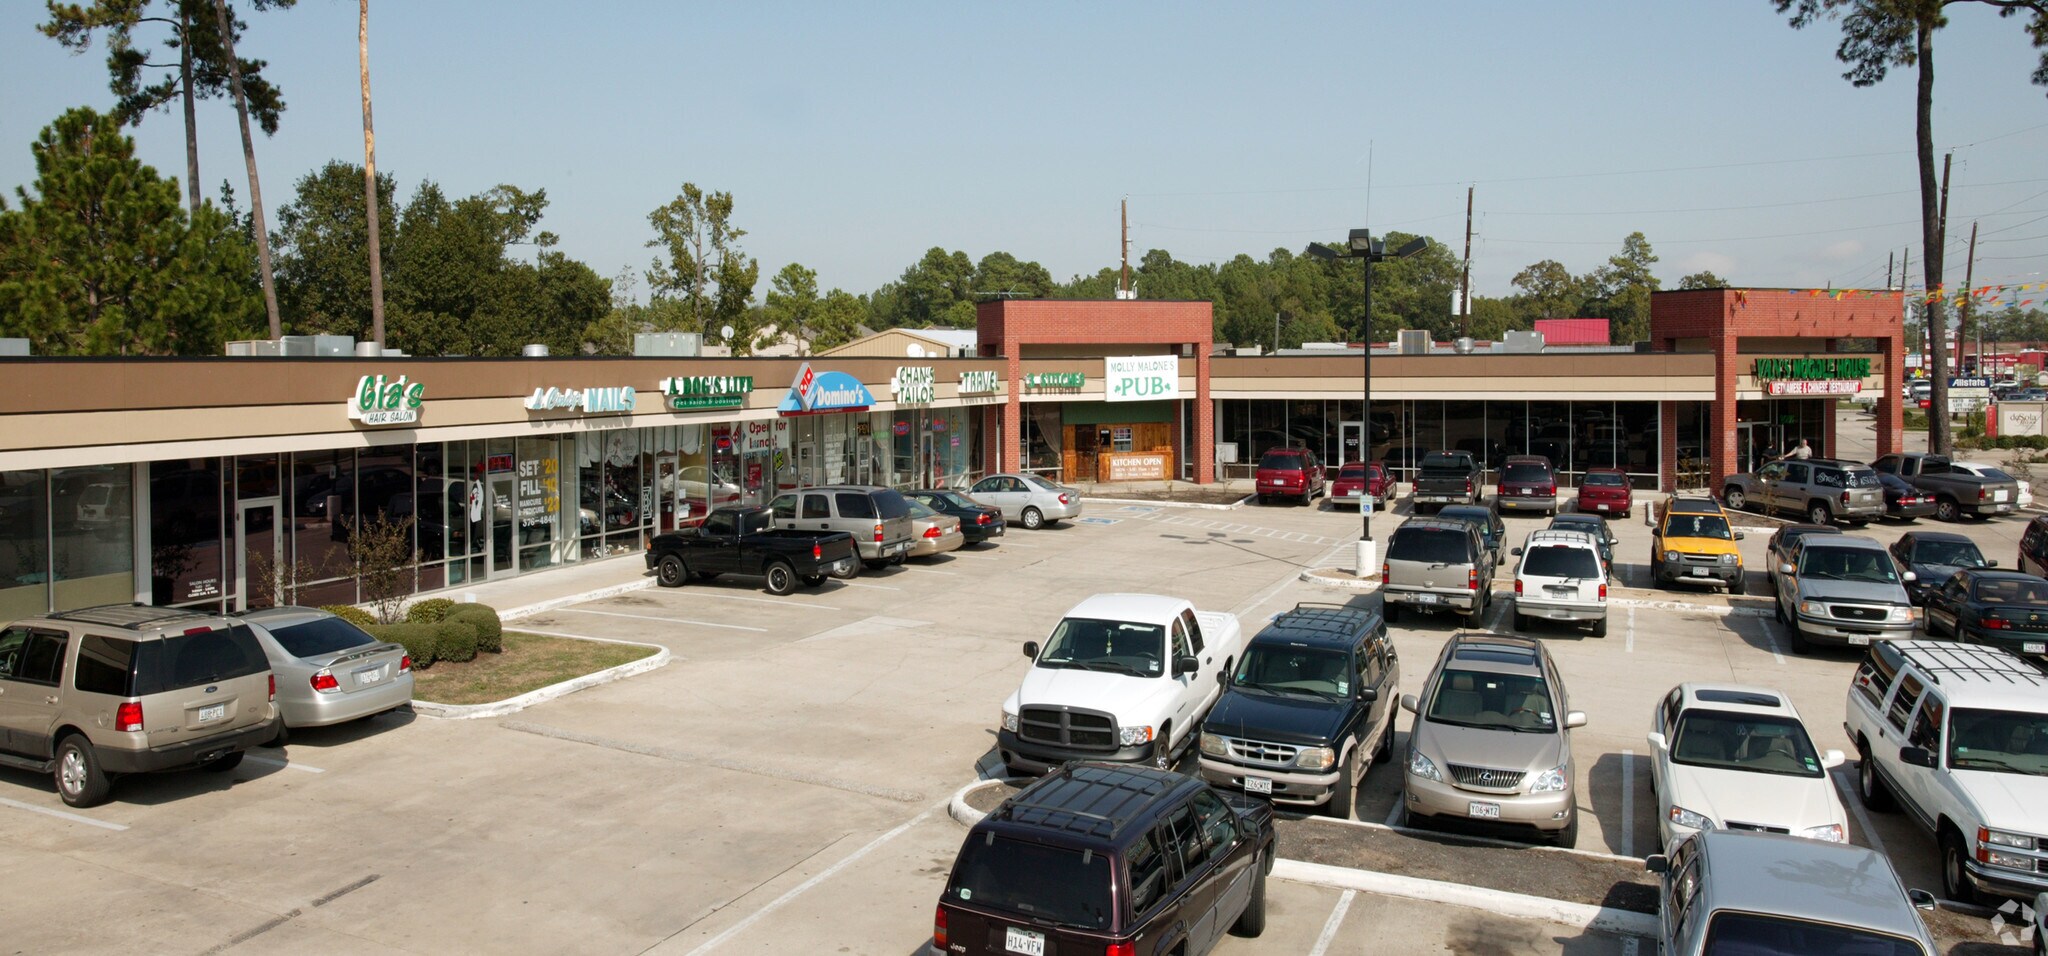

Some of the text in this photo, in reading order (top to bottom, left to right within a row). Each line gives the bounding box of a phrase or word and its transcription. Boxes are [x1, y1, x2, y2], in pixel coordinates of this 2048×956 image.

[1111, 361, 1175, 372] MOLLY MALONE'S
[1757, 358, 1871, 378] VAN'S NOODLE HOUSE
[899, 367, 934, 384] CHAN'S
[962, 371, 1000, 392] TRAVEL
[1952, 378, 1986, 387] Allstate
[357, 375, 425, 410] Gia's
[683, 376, 721, 394] DOG'S
[724, 376, 753, 393] LIFE
[1121, 376, 1164, 396] PUB
[1808, 382, 1829, 394] CHINESE
[1830, 381, 1859, 393] RESTAURANT
[583, 385, 636, 413] NAILS
[817, 384, 864, 406] Domino's
[898, 386, 935, 403] TAILOR
[368, 412, 414, 424] HAIR SALON
[775, 419, 787, 431] for
[520, 460, 539, 477] SET
[521, 480, 541, 496] FILL
[519, 498, 541, 507] MANICURE
[523, 506, 545, 515] PEDICURE
[522, 515, 556, 527] 376-4844
